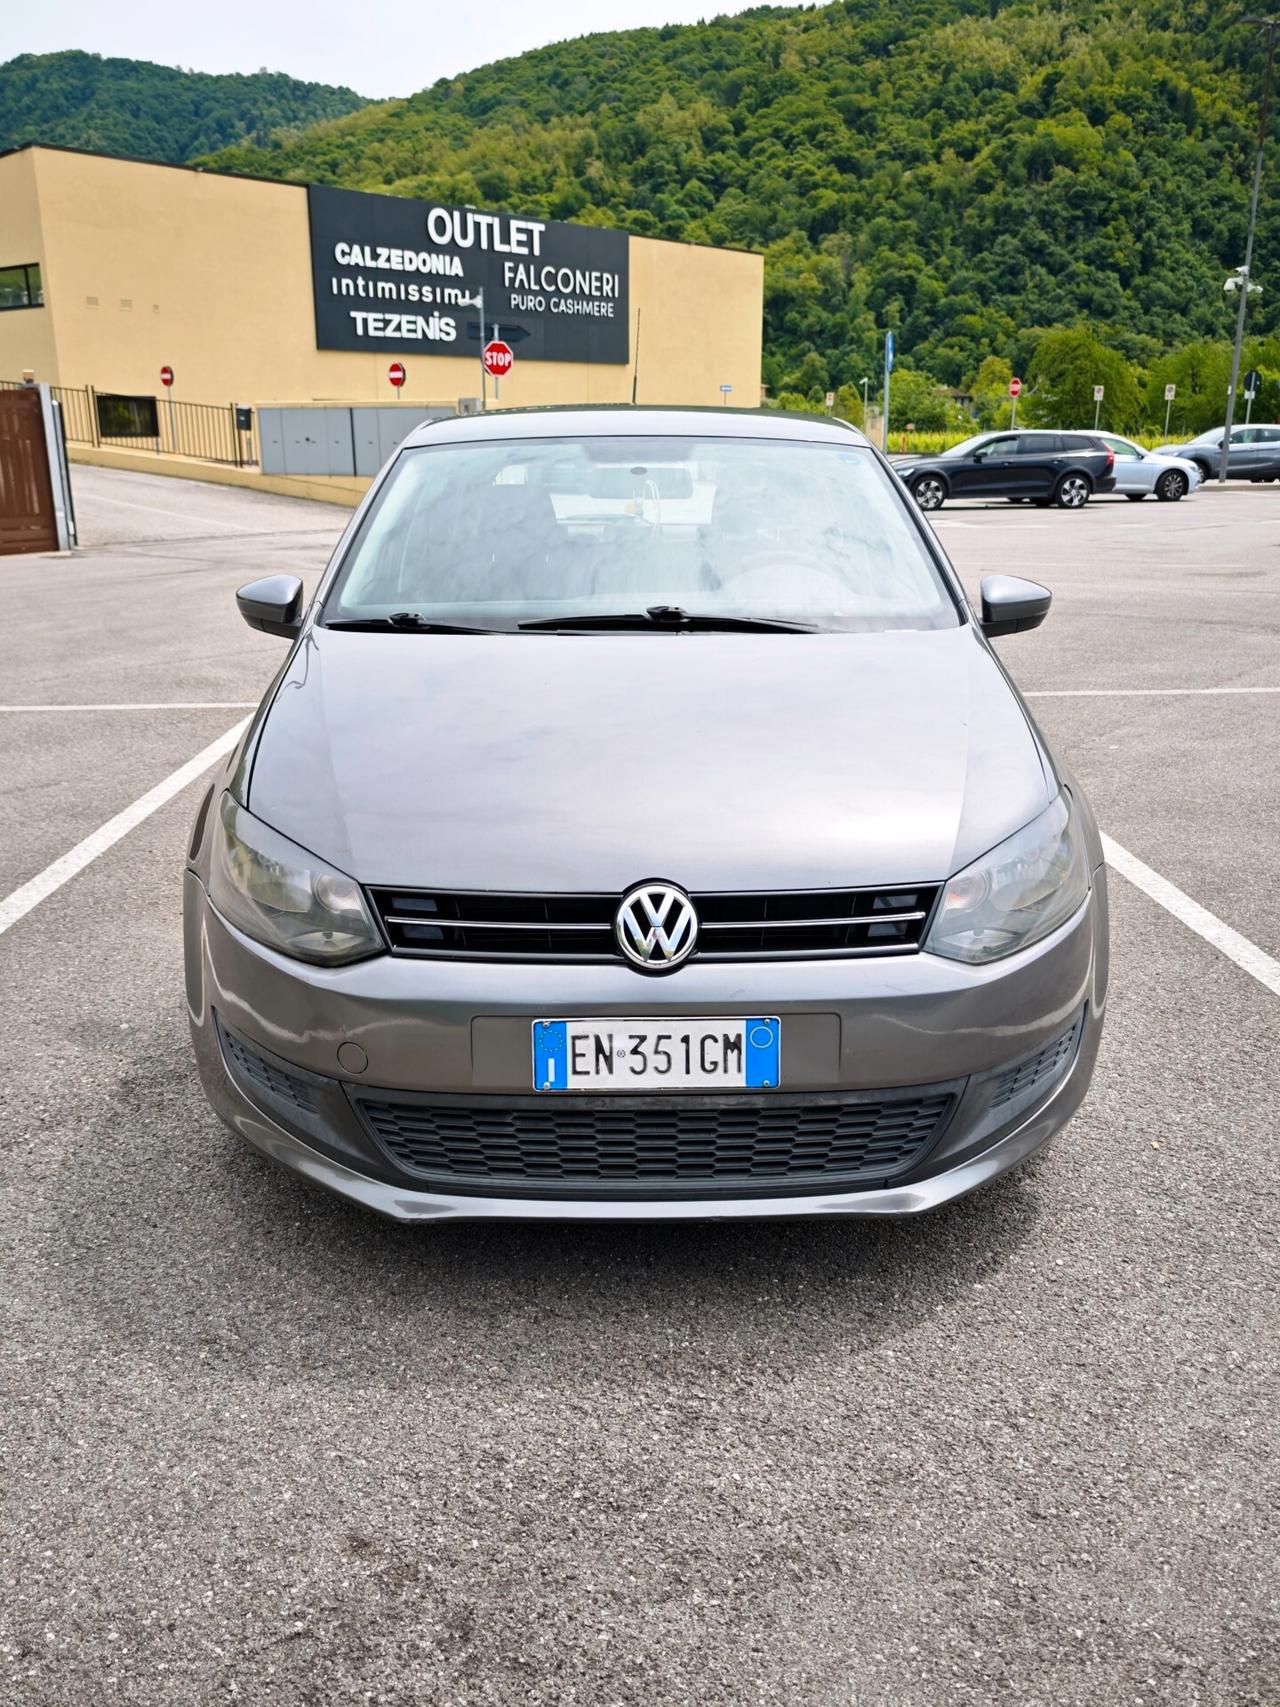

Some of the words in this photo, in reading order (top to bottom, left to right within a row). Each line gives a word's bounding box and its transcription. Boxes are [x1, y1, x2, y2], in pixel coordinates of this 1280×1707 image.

[427, 207, 546, 257] OUTLET
[334, 242, 464, 277] CALZEDONIA
[503, 261, 619, 298] FALCONERI
[511, 293, 546, 312] PURO
[549, 297, 615, 318] CASHMERE
[485, 351, 512, 367] STOP
